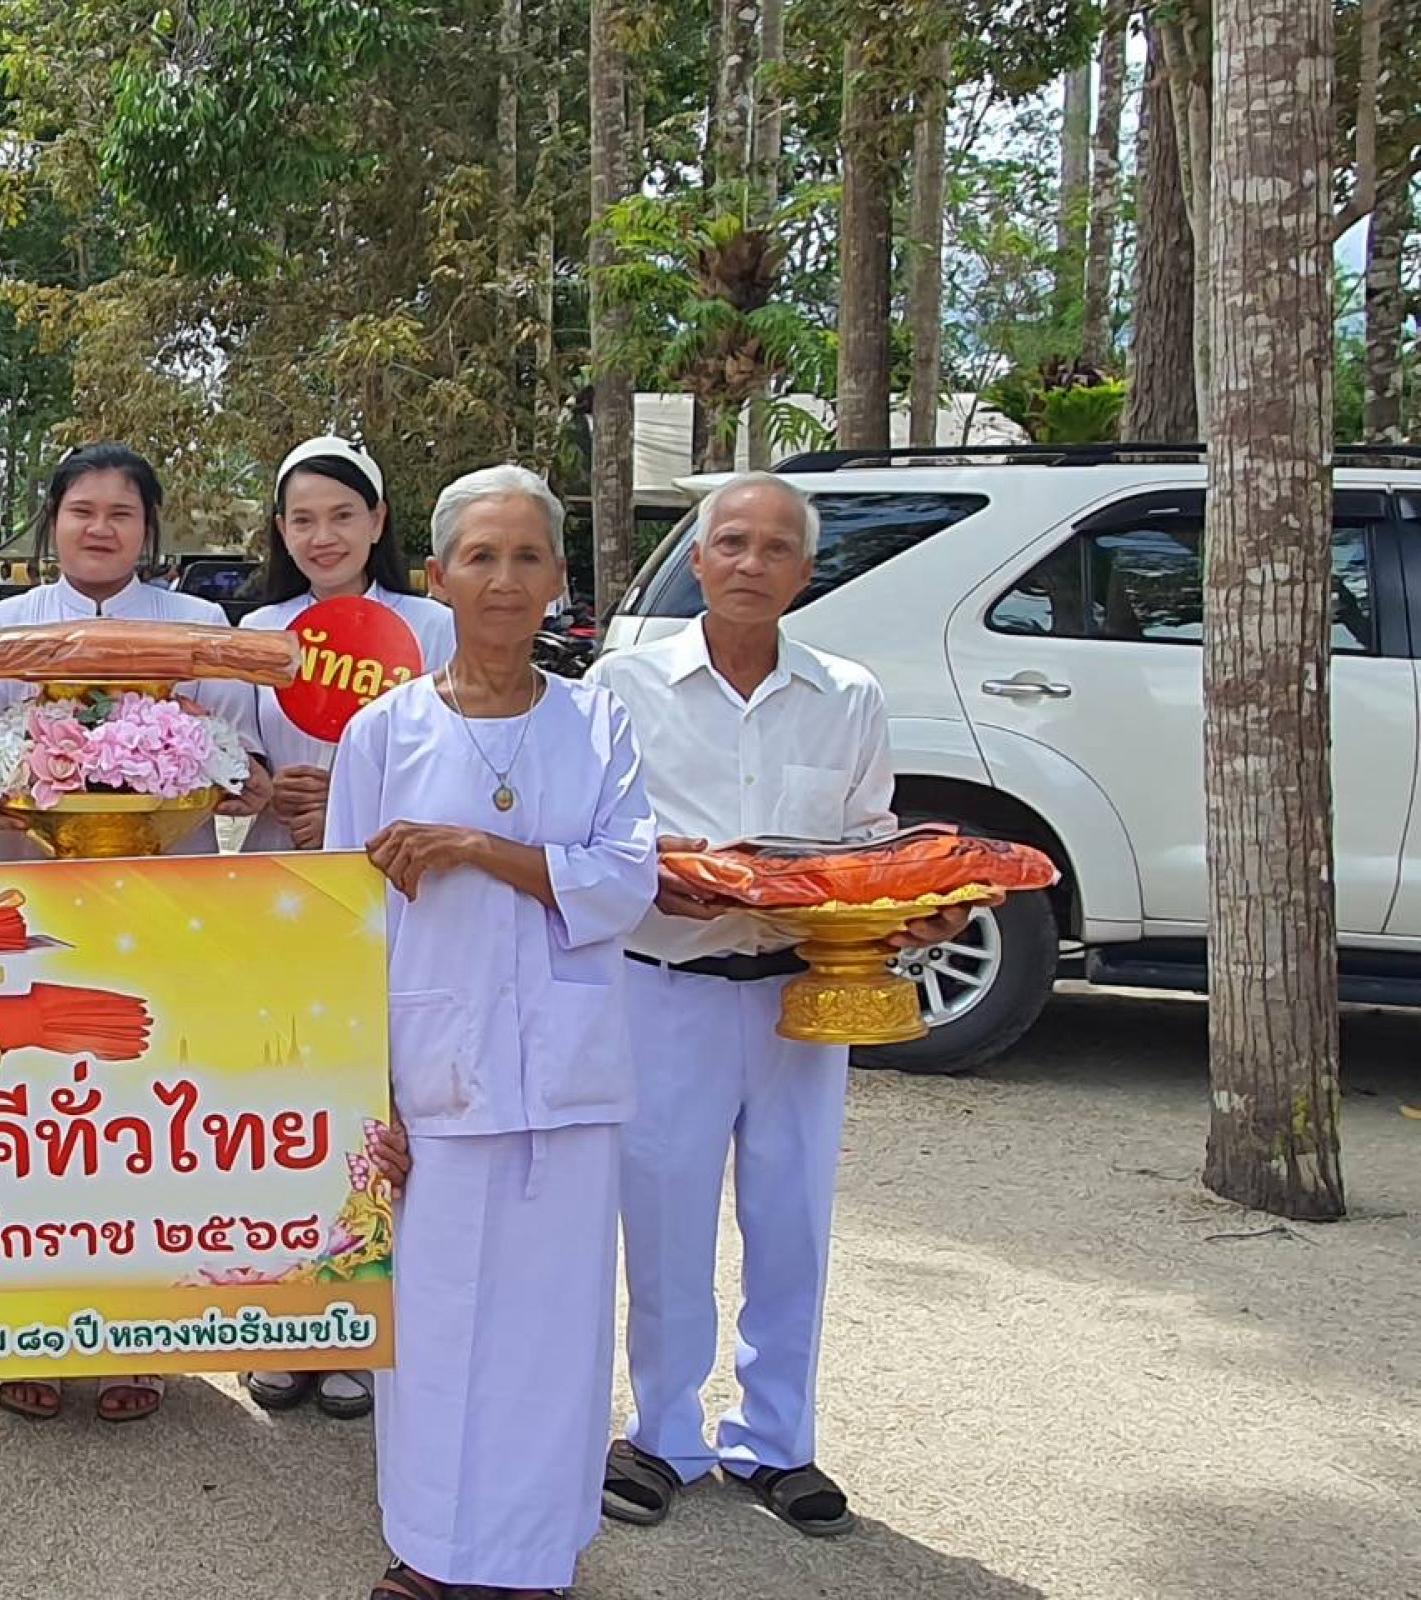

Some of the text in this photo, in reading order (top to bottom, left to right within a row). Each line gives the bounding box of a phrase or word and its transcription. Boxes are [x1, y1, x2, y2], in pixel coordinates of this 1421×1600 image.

[153, 1215, 319, 1253] ๒๕๖๘
[16, 1328, 65, 1352] ๘๑
[74, 1313, 100, 1350] ปี
[108, 1307, 371, 1349] หลวงพ่อธัมมชโย
